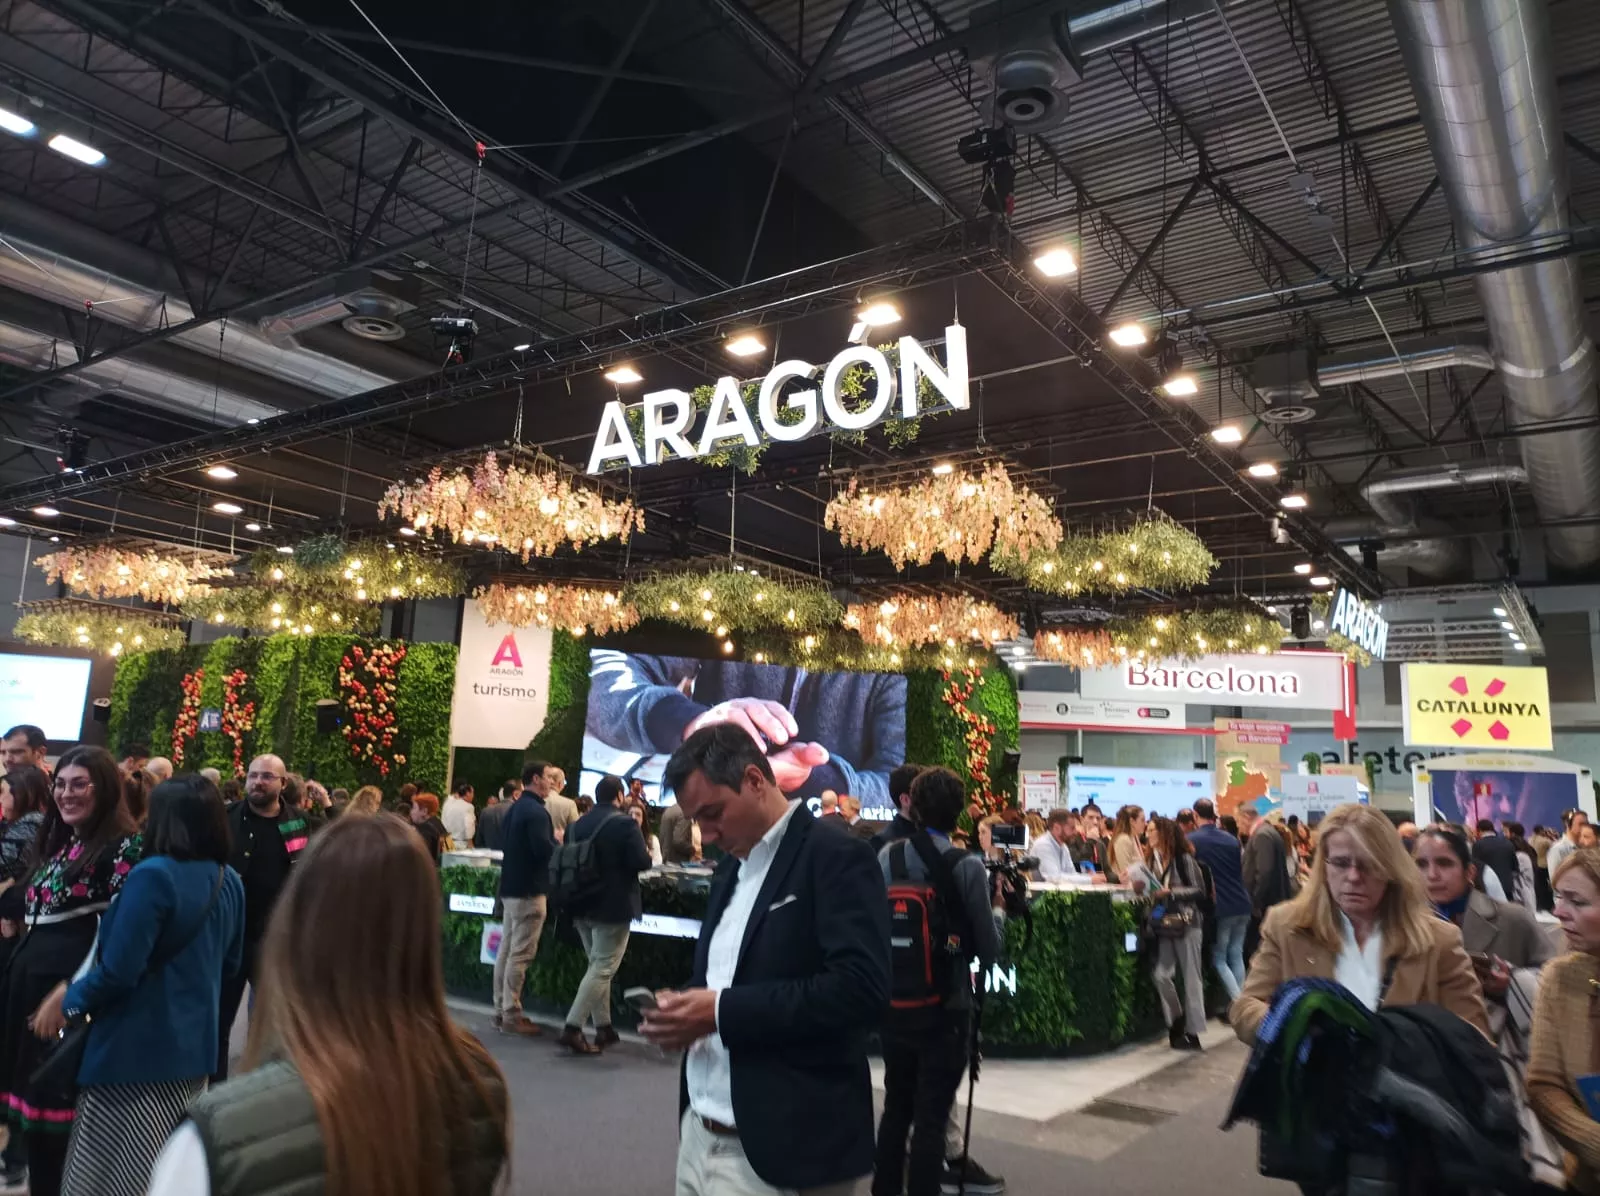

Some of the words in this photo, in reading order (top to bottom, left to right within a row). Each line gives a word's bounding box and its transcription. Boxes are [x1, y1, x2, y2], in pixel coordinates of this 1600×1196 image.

[586, 322, 970, 475] ARAGÓN
[1331, 588, 1388, 660] ARAGÓN
[491, 632, 523, 668] A
[490, 668, 523, 676] ARAGÓN
[1127, 664, 1299, 695] Barcelona
[473, 682, 536, 699] turismo
[1416, 699, 1541, 716] CATALUNYA
